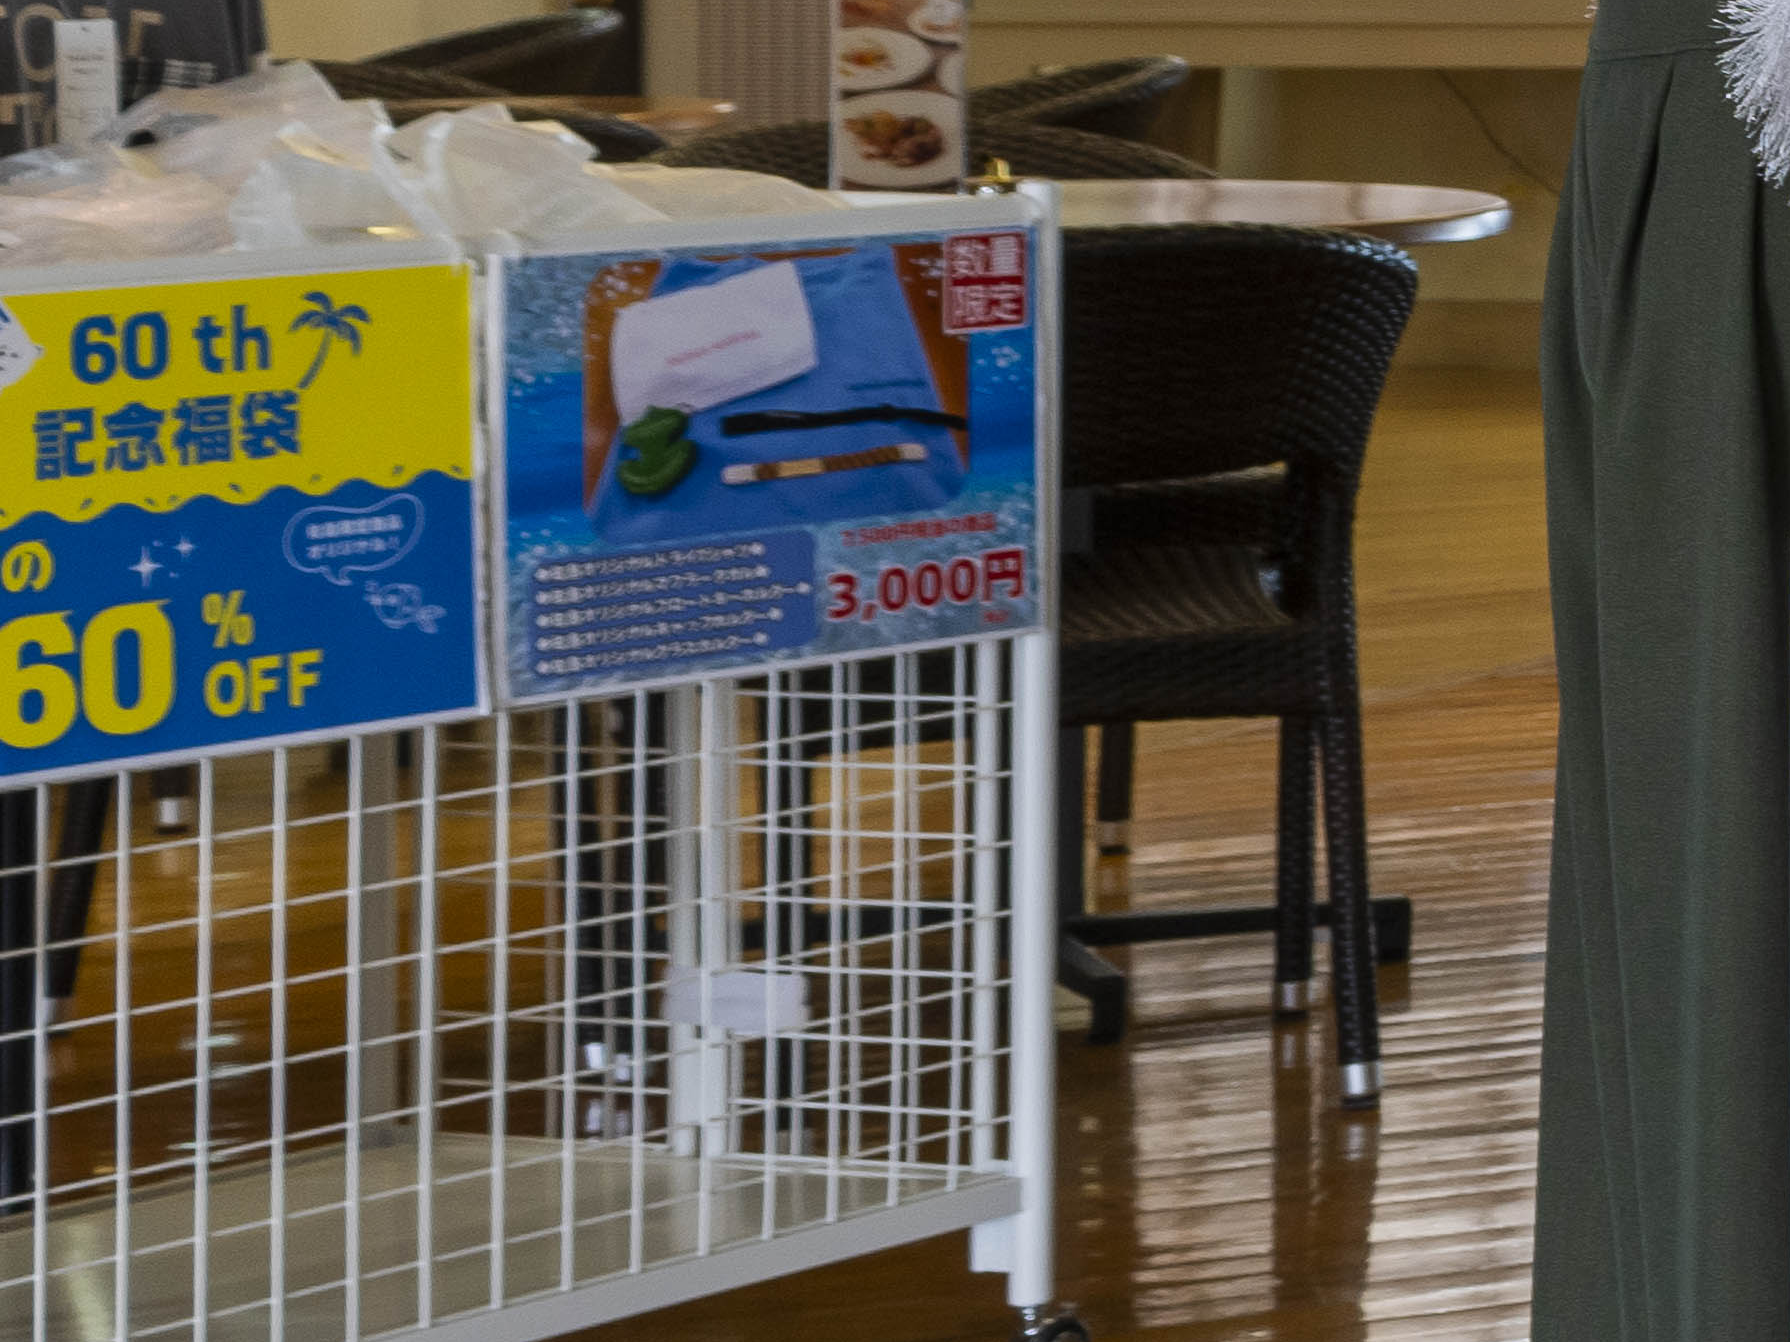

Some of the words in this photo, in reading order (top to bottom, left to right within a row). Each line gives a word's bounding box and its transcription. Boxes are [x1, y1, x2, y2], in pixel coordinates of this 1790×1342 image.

[72, 310, 169, 385] 60
[194, 304, 273, 373] th
[34, 392, 301, 481] 記念福袋
[826, 546, 1026, 622] 3,000円
[203, 647, 323, 720] OFF
